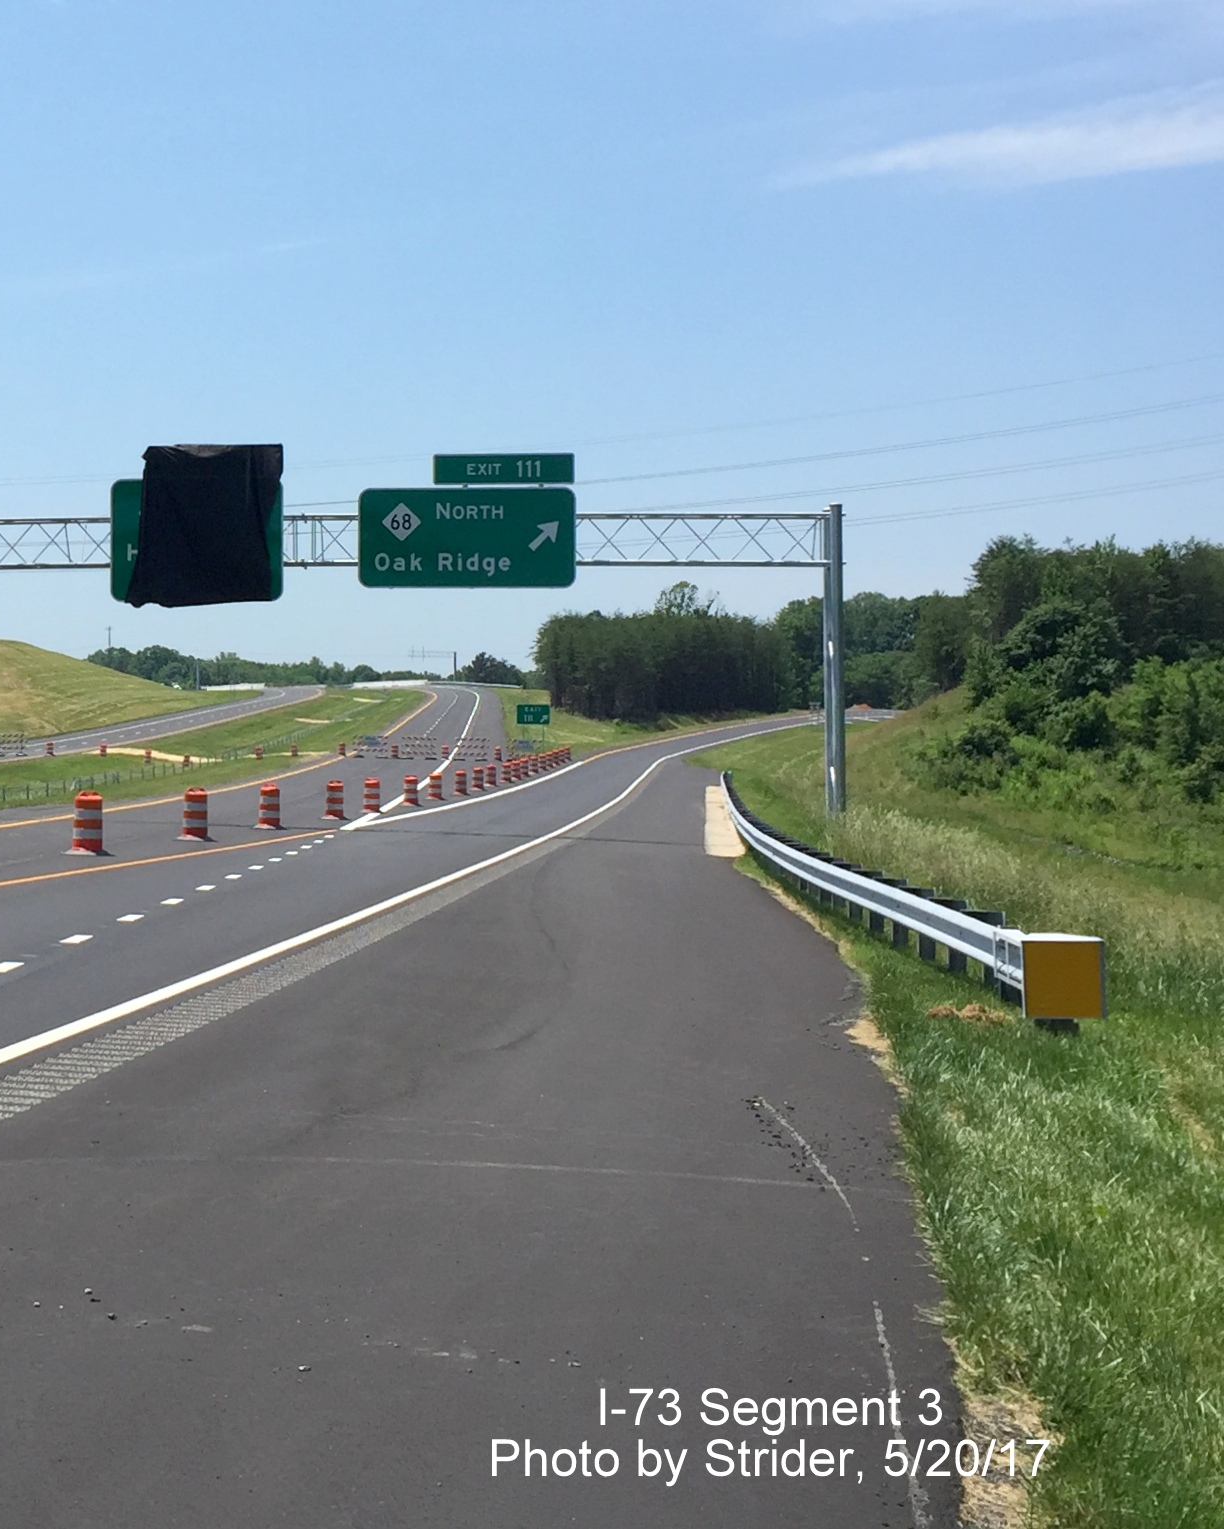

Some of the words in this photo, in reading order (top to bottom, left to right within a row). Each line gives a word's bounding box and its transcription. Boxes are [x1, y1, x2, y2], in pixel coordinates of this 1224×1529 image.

[466, 463, 501, 476] EXIT
[516, 460, 541, 478] 111
[390, 513, 412, 531] 68
[435, 502, 504, 519] NORTH
[374, 552, 423, 571] Oak
[437, 552, 512, 577] Ridge
